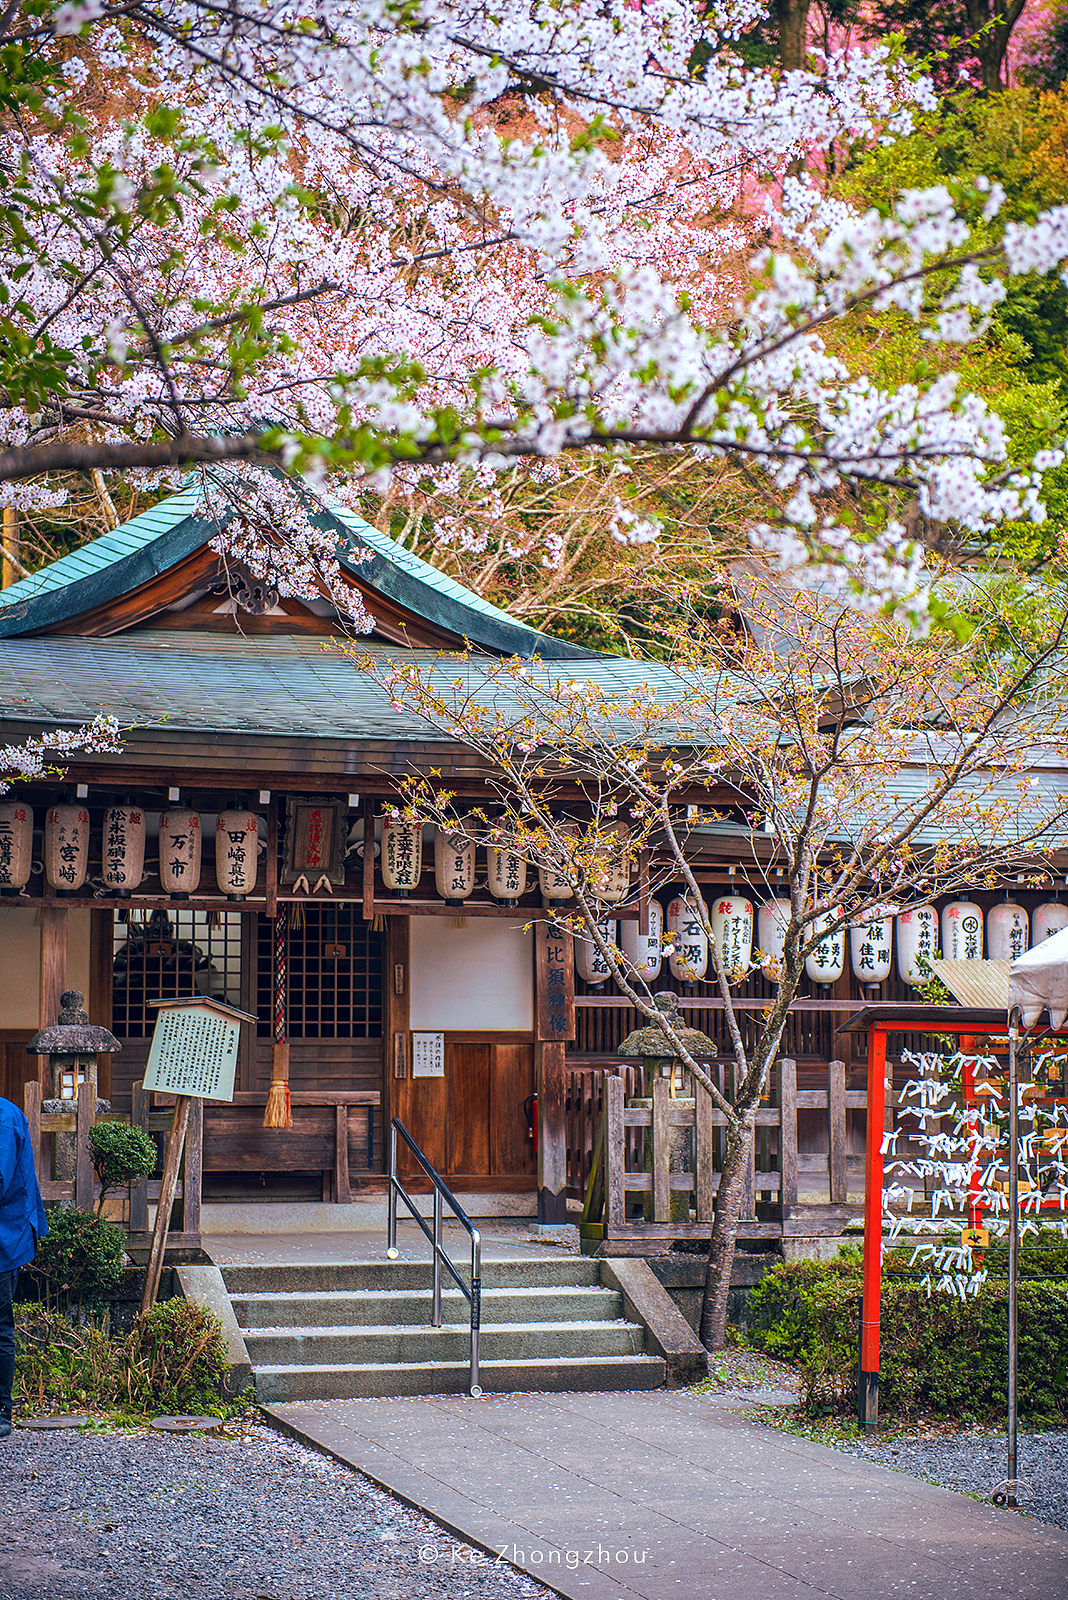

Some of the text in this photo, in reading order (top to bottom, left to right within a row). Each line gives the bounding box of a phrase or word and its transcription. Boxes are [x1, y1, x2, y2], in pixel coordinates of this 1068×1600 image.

[168, 833, 189, 879] 万市
[451, 856, 468, 891] 豆政
[682, 920, 703, 965] 石源
